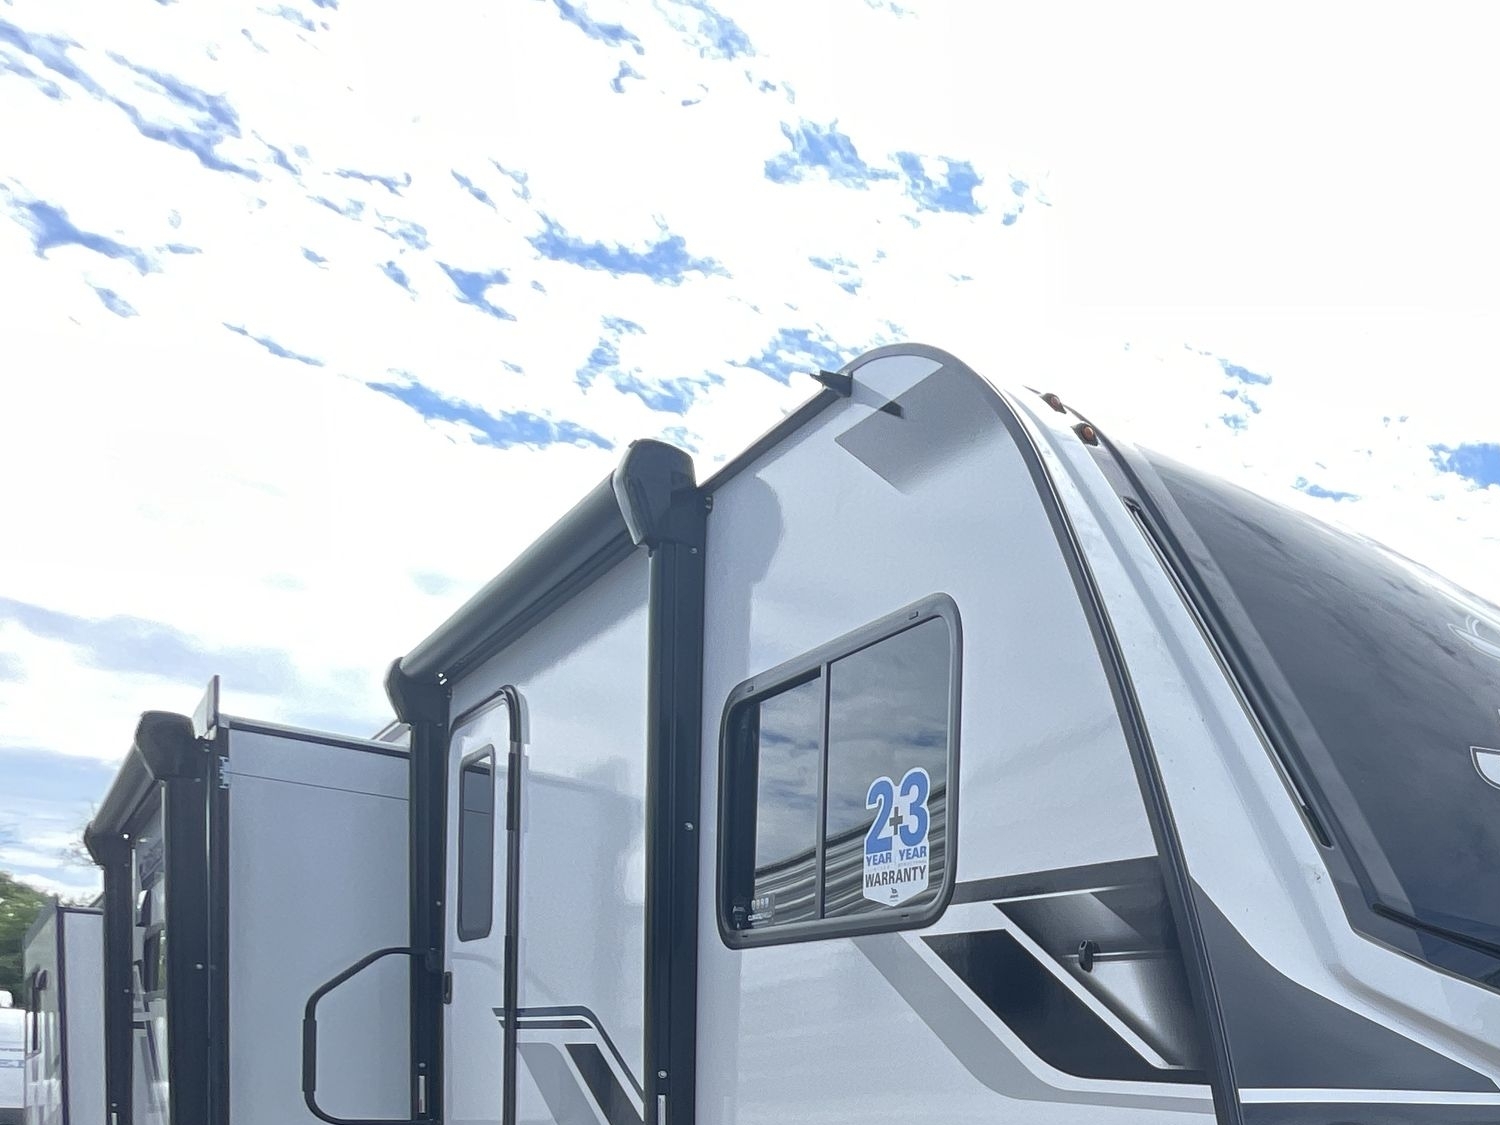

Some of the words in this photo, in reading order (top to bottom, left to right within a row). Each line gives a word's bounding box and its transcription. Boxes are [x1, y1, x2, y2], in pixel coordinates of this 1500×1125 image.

[866, 852, 892, 867] YEAR
[899, 845, 927, 861] YEAR
[865, 865, 927, 888] WARRANTY
